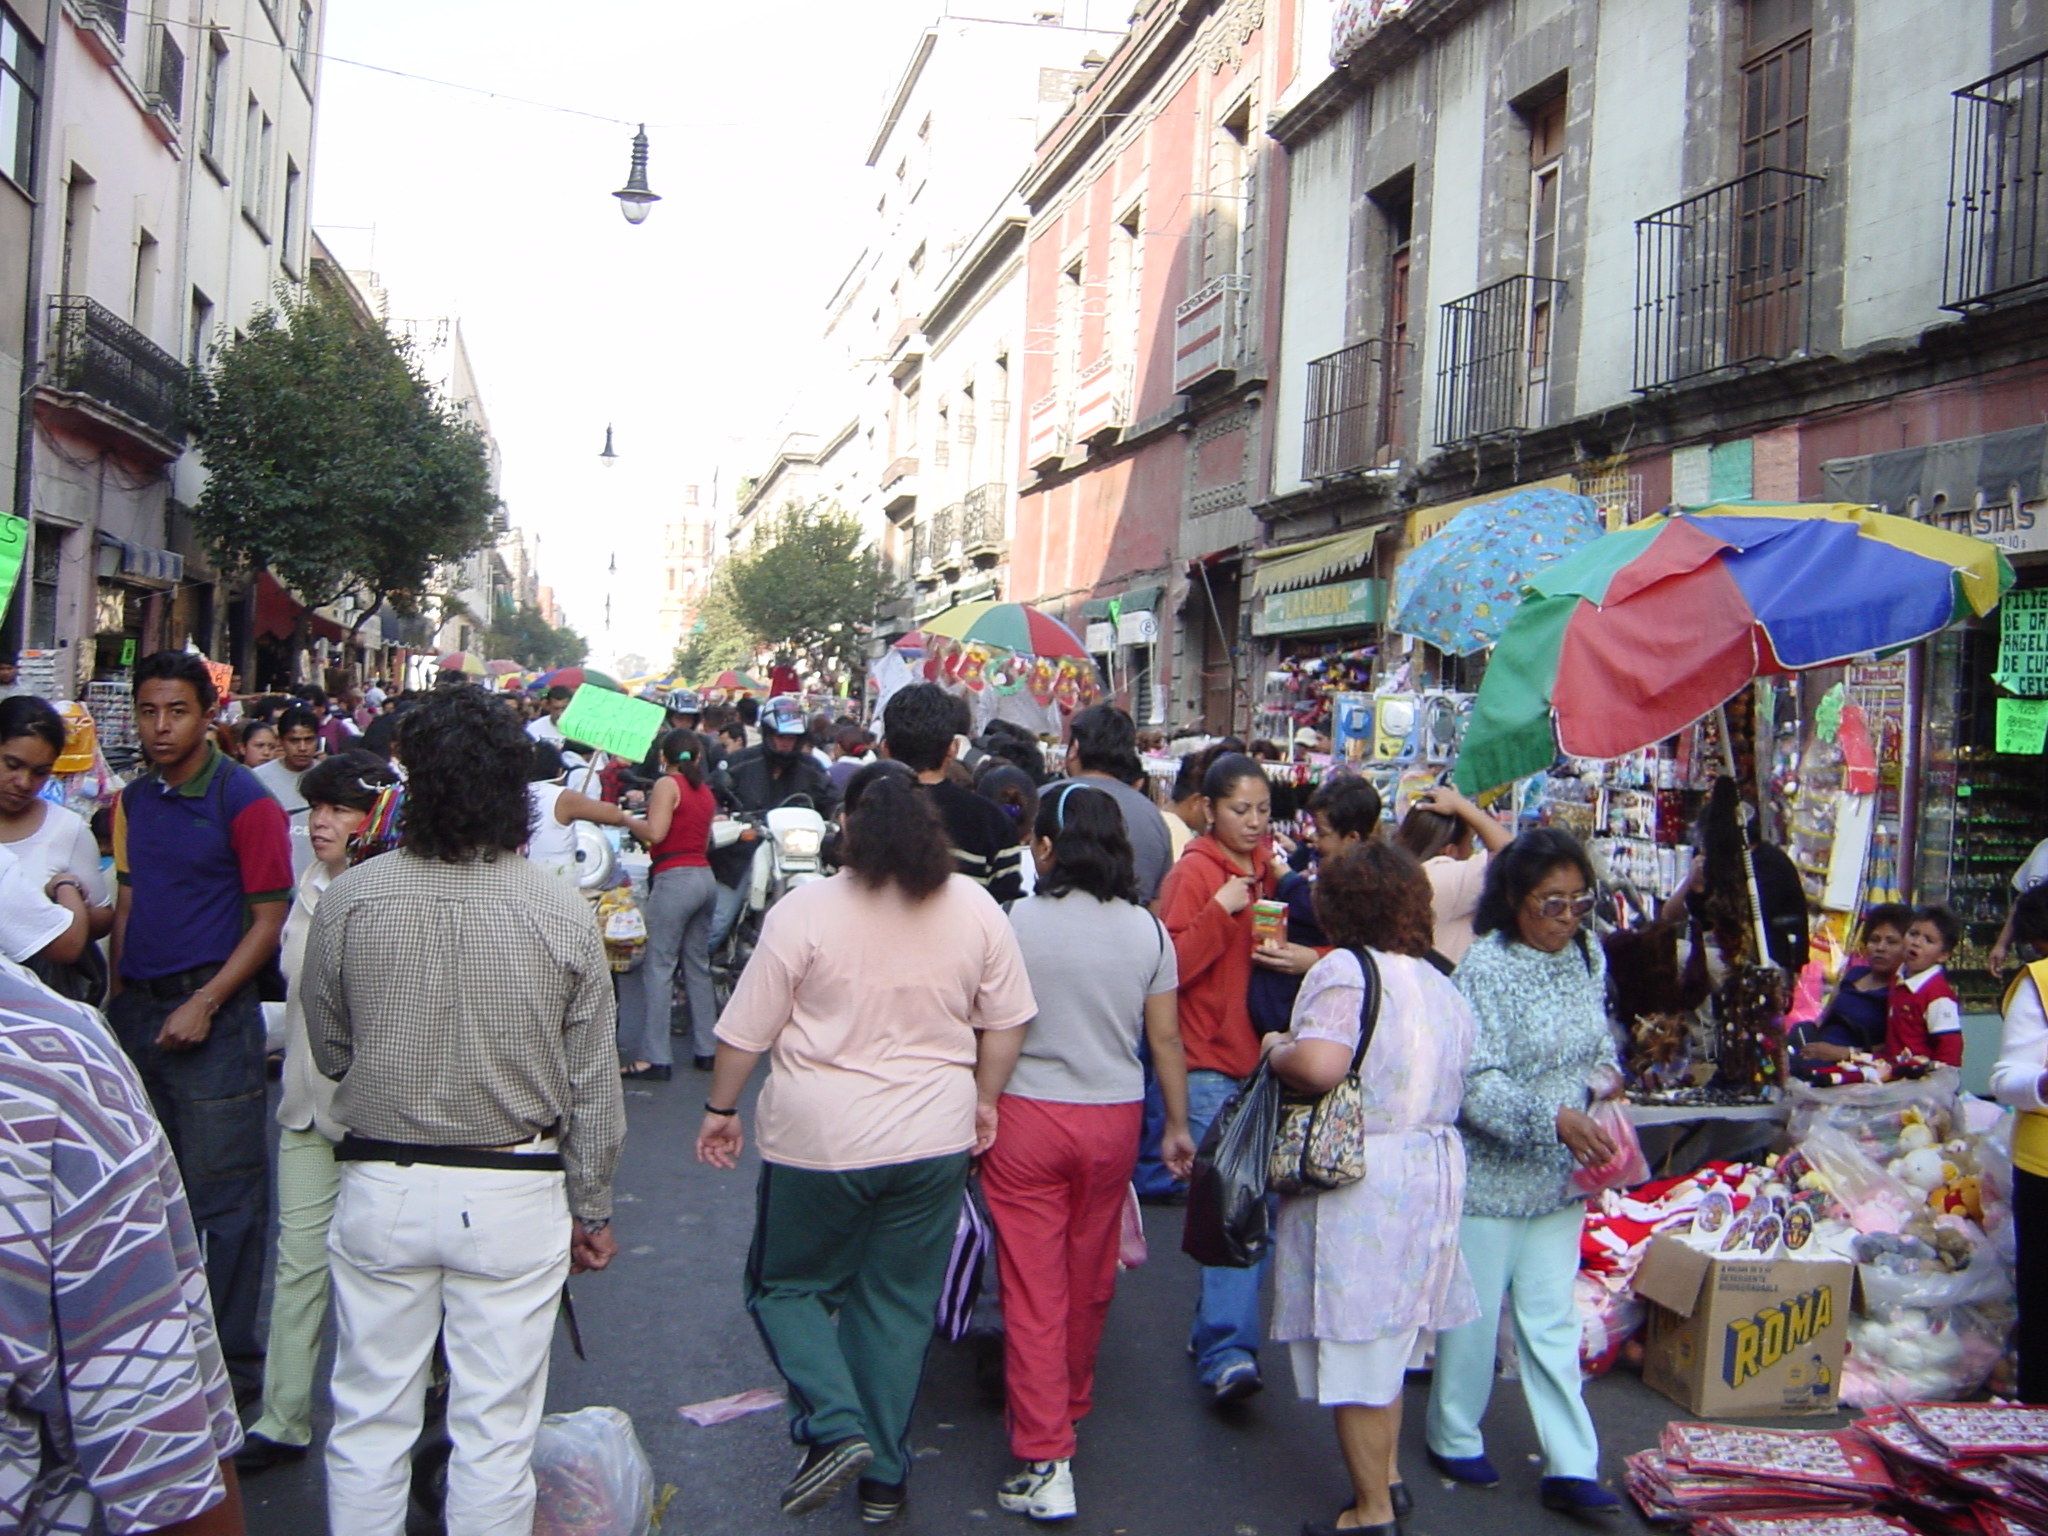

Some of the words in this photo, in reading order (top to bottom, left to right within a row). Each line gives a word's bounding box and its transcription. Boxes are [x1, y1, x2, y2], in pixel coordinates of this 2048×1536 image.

[1303, 585, 1350, 616] CADENA
[2004, 613, 2020, 632] DE
[2003, 633, 2048, 652] ANGEL
[2003, 655, 2019, 673] DE
[1722, 1284, 1832, 1390] ROMA
